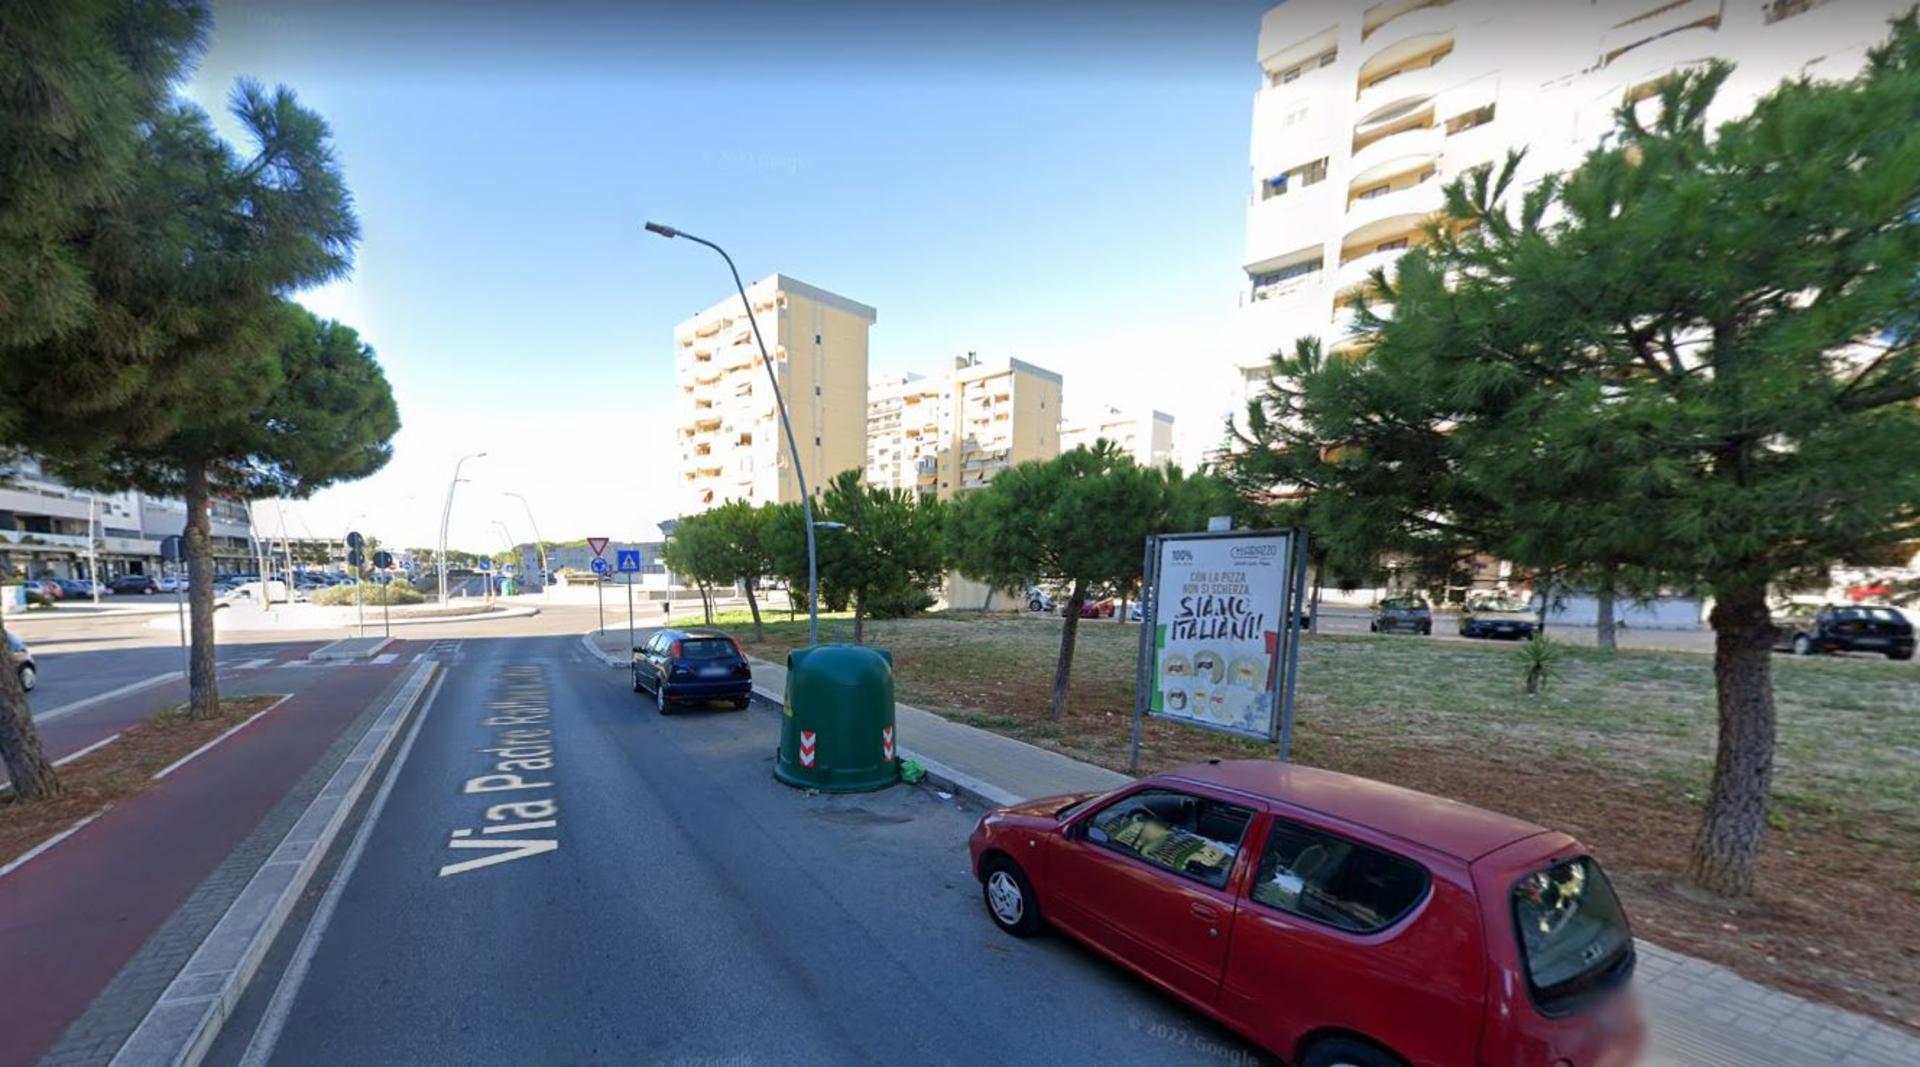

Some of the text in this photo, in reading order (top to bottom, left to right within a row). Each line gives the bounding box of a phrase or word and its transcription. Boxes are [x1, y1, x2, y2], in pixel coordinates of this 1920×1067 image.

[1172, 550, 1193, 561] 100%
[1190, 571, 1247, 582] CON LA PIZZA
[1183, 583, 1198, 595] NON
[1201, 583, 1209, 594] SI
[1176, 595, 1251, 620] SIAMO
[1172, 612, 1264, 641] ITALIANI!
